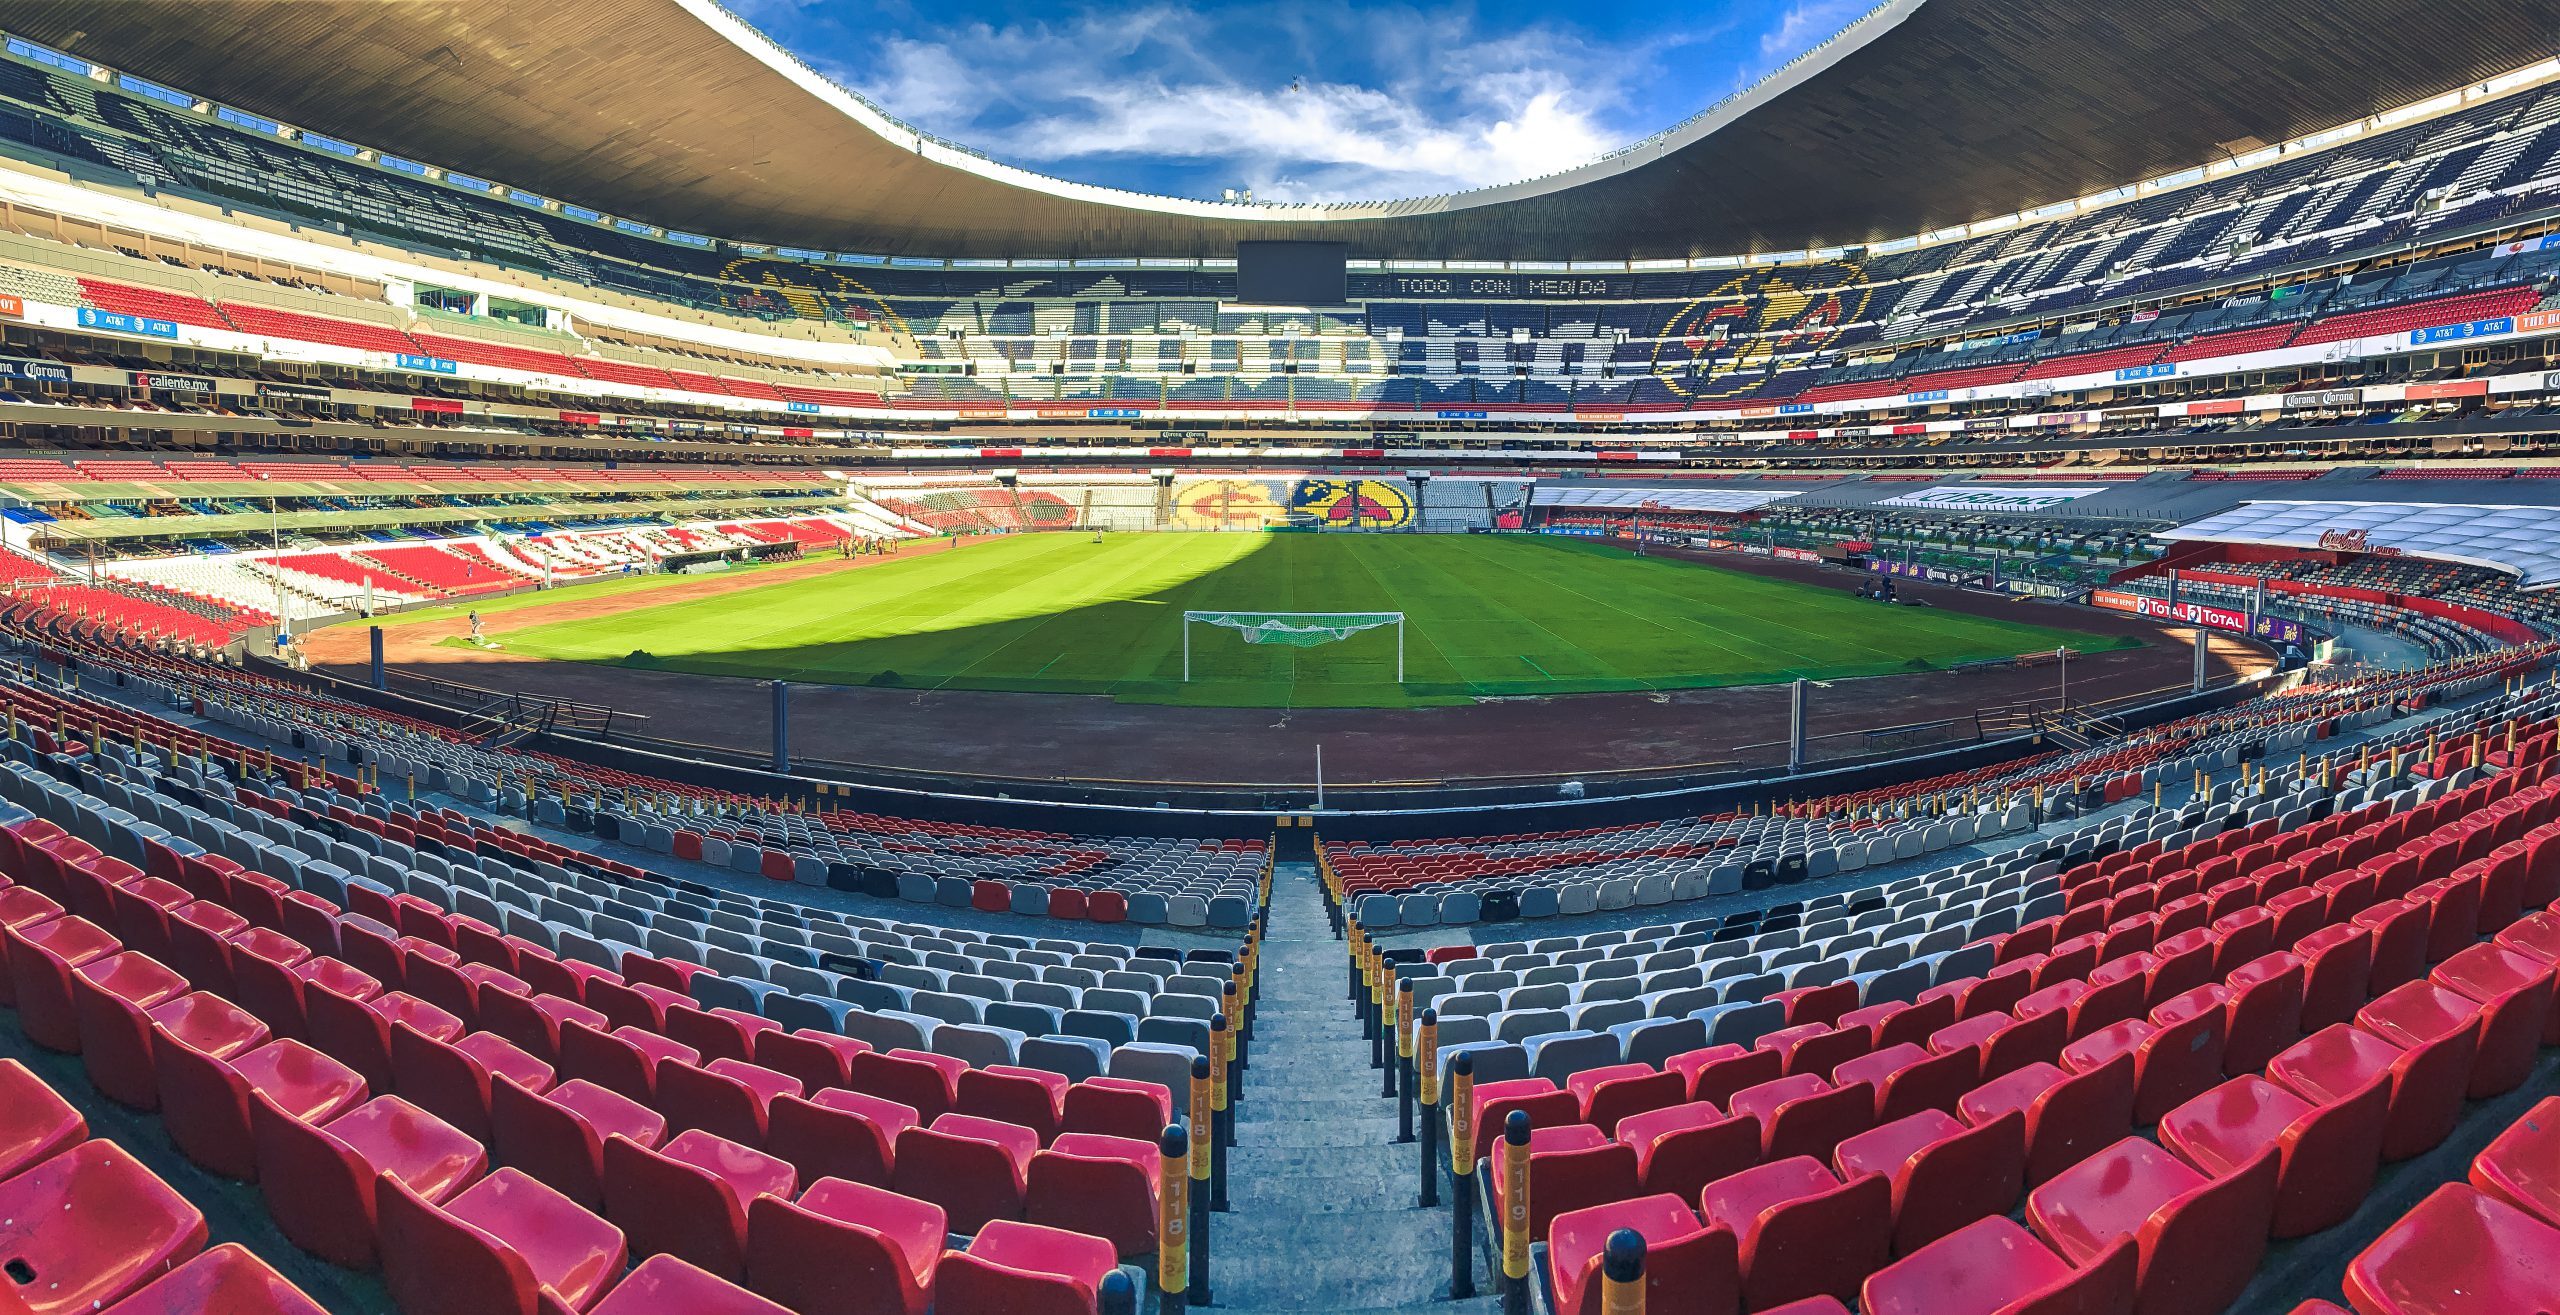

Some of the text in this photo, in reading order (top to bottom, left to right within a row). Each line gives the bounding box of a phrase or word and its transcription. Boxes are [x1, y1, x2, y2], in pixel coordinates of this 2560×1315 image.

[1397, 278, 1607, 294] TODO CON MEDIDA
[105, 315, 171, 333] AT&T AT&T
[2435, 321, 2504, 338] AT&T AT&T
[2523, 314, 2545, 328] THE
[24, 362, 67, 380] Corona
[412, 358, 453, 369] AT&T AT&T
[150, 374, 209, 391] caliente.mx
[2286, 390, 2355, 407] Corona Corona
[1926, 568, 1947, 581] Corona
[2104, 596, 2119, 605] HOME
[2119, 598, 2136, 608] DEPOT
[2203, 609, 2243, 629] TOTAL
[1211, 1044, 1220, 1077] 118
[1424, 1039, 1434, 1070] 119
[1194, 1096, 1206, 1136] 118
[1457, 1093, 1468, 1132] 119
[1512, 1167, 1527, 1221] 119
[1168, 1180, 1183, 1235] 118
